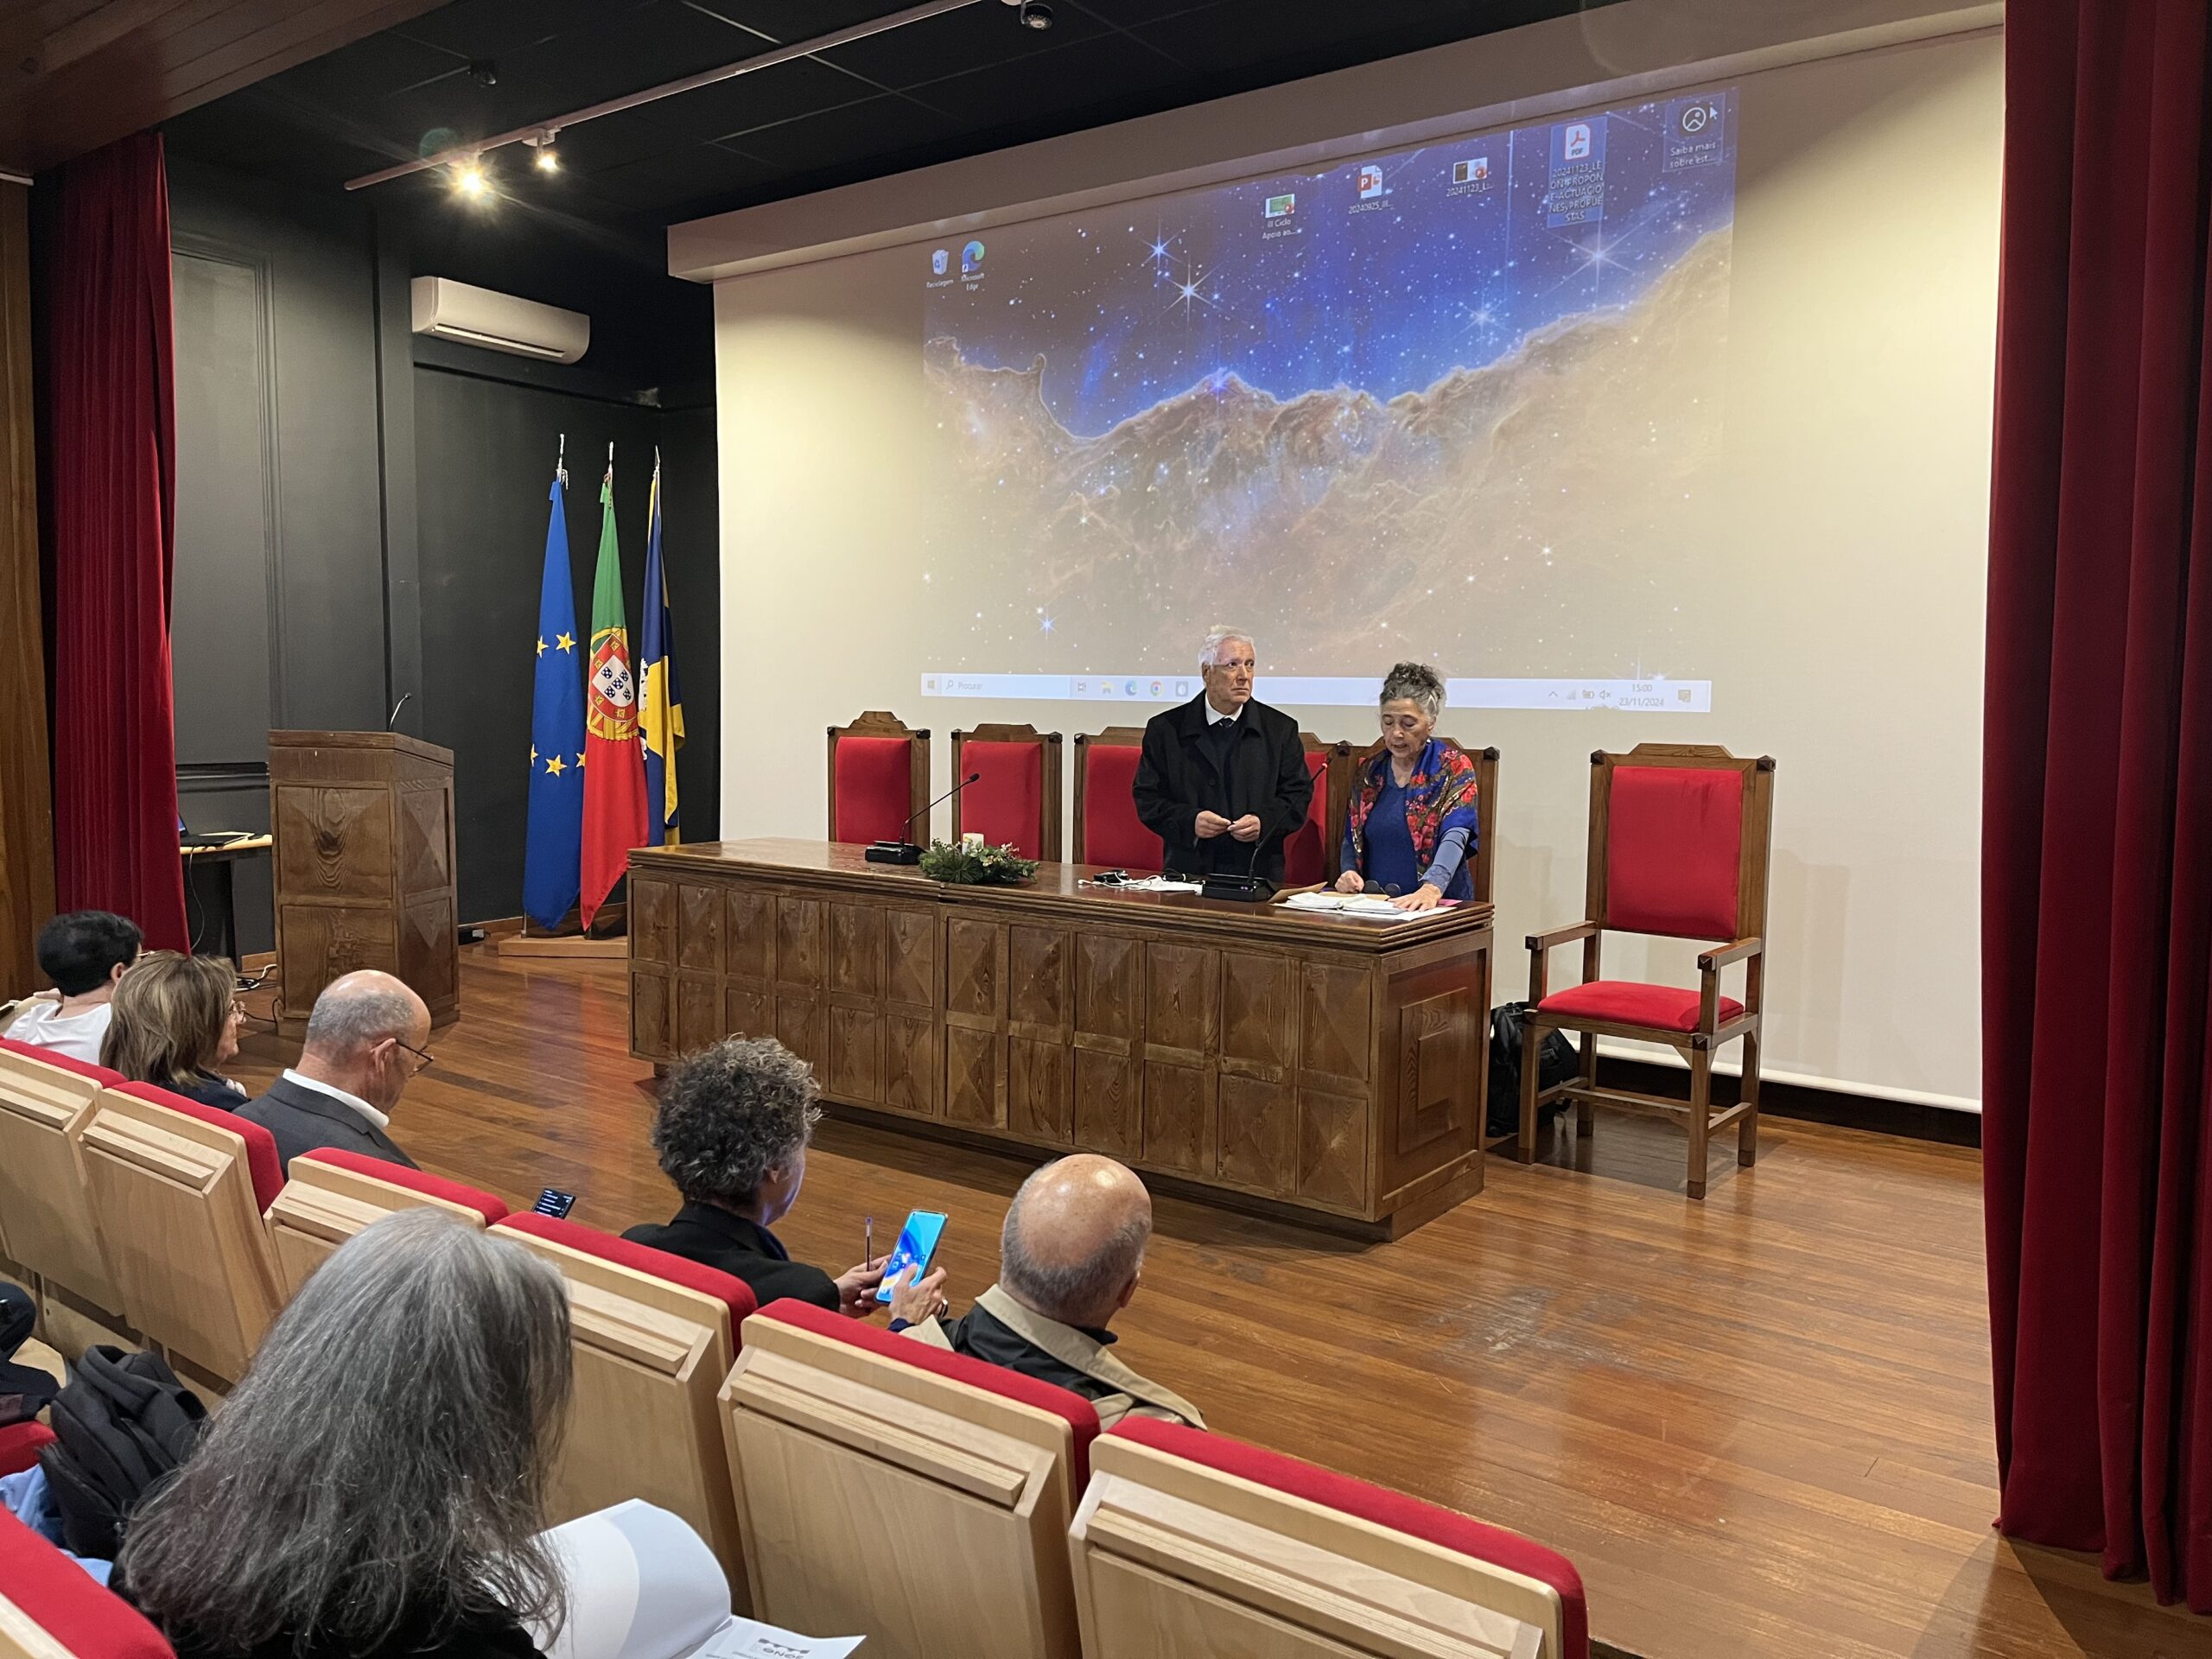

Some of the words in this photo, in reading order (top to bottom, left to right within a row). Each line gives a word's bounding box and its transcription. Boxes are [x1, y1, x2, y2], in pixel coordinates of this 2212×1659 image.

[1669, 146, 1694, 156] Saiba
[1694, 141, 1717, 152] mais
[1669, 157, 1694, 168] sobre
[1632, 683, 1652, 692] 15:00
[1618, 697, 1664, 707] 23/11/2024
